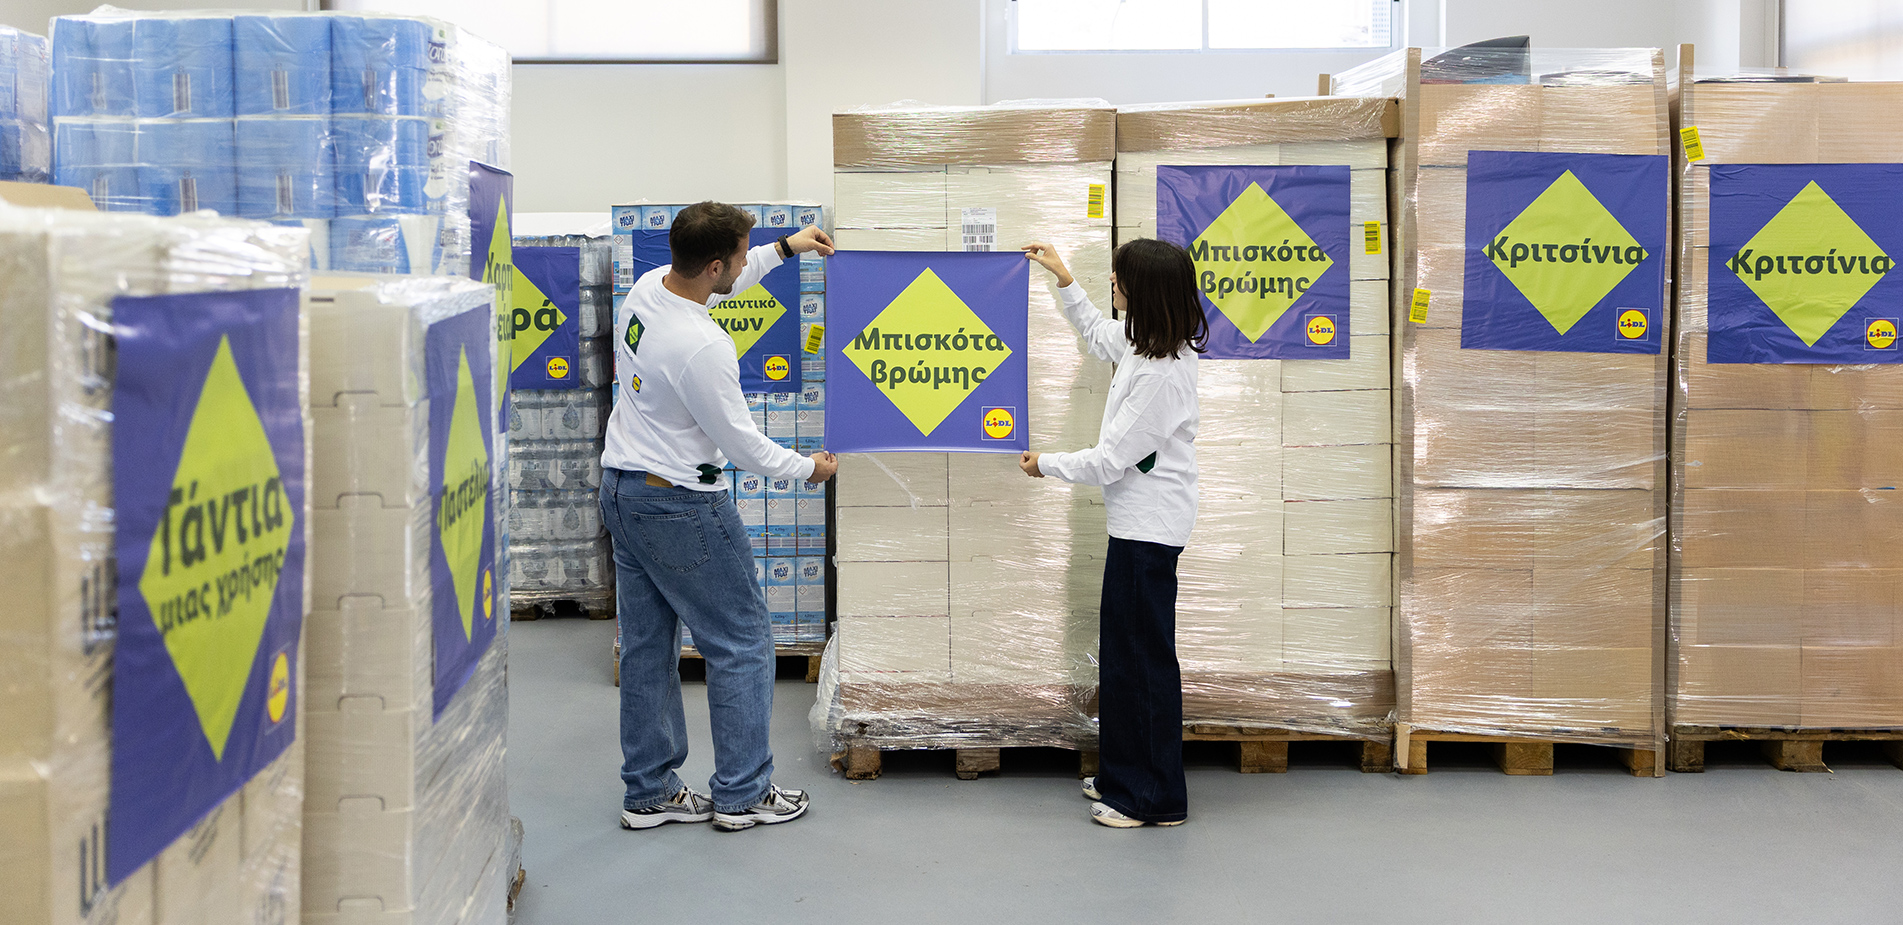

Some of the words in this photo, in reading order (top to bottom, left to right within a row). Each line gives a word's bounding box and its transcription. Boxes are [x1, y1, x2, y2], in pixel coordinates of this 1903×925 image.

[1189, 239, 1326, 262] Μπισκότα
[1488, 236, 1644, 268] Κριτσίνια
[1732, 248, 1890, 281] Κριτσίνια
[1200, 270, 1310, 299] βρώμης
[511, 299, 562, 340] ρά
[709, 313, 764, 335] χων
[854, 327, 1005, 351] Μπισκότα
[870, 359, 987, 390] βρώμης
[160, 475, 284, 578] Τάντια
[159, 581, 212, 635] μιας
[215, 547, 284, 619] χρήσης
